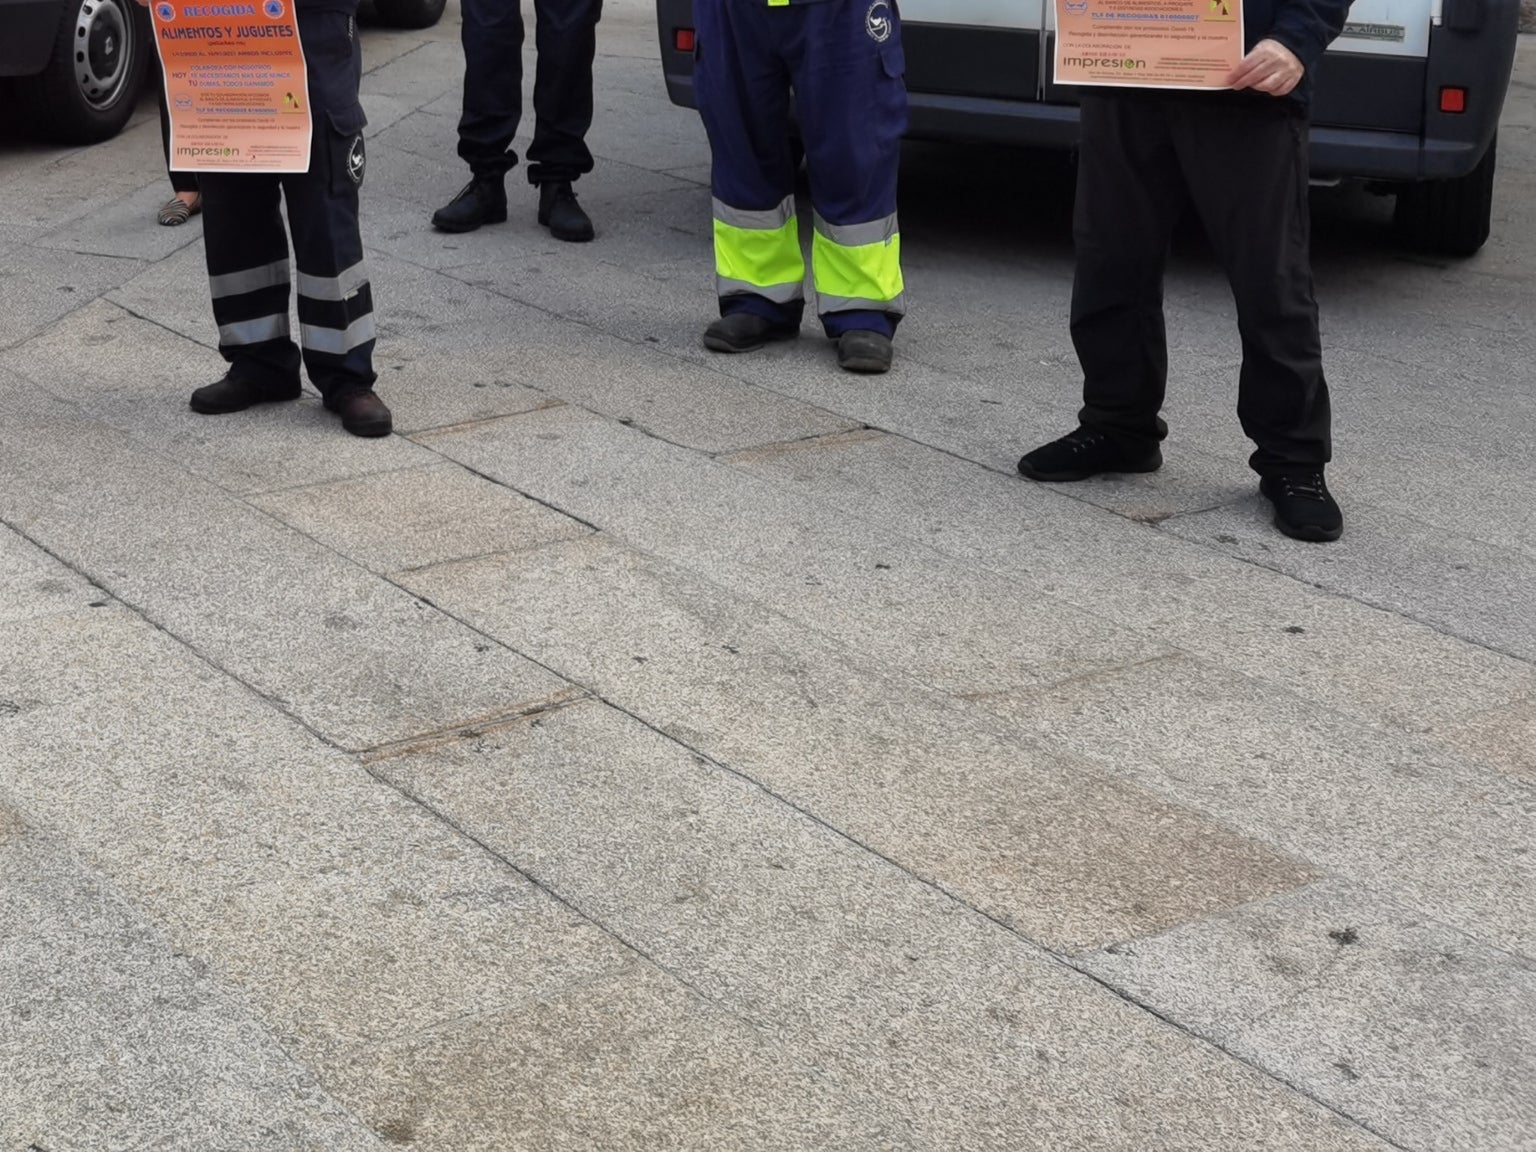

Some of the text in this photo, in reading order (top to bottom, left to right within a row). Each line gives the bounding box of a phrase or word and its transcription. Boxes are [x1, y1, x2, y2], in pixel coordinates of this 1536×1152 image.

[183, 4, 256, 17] RECOGIDA
[162, 25, 293, 40] ALIMENTOS Y JUGUETES
